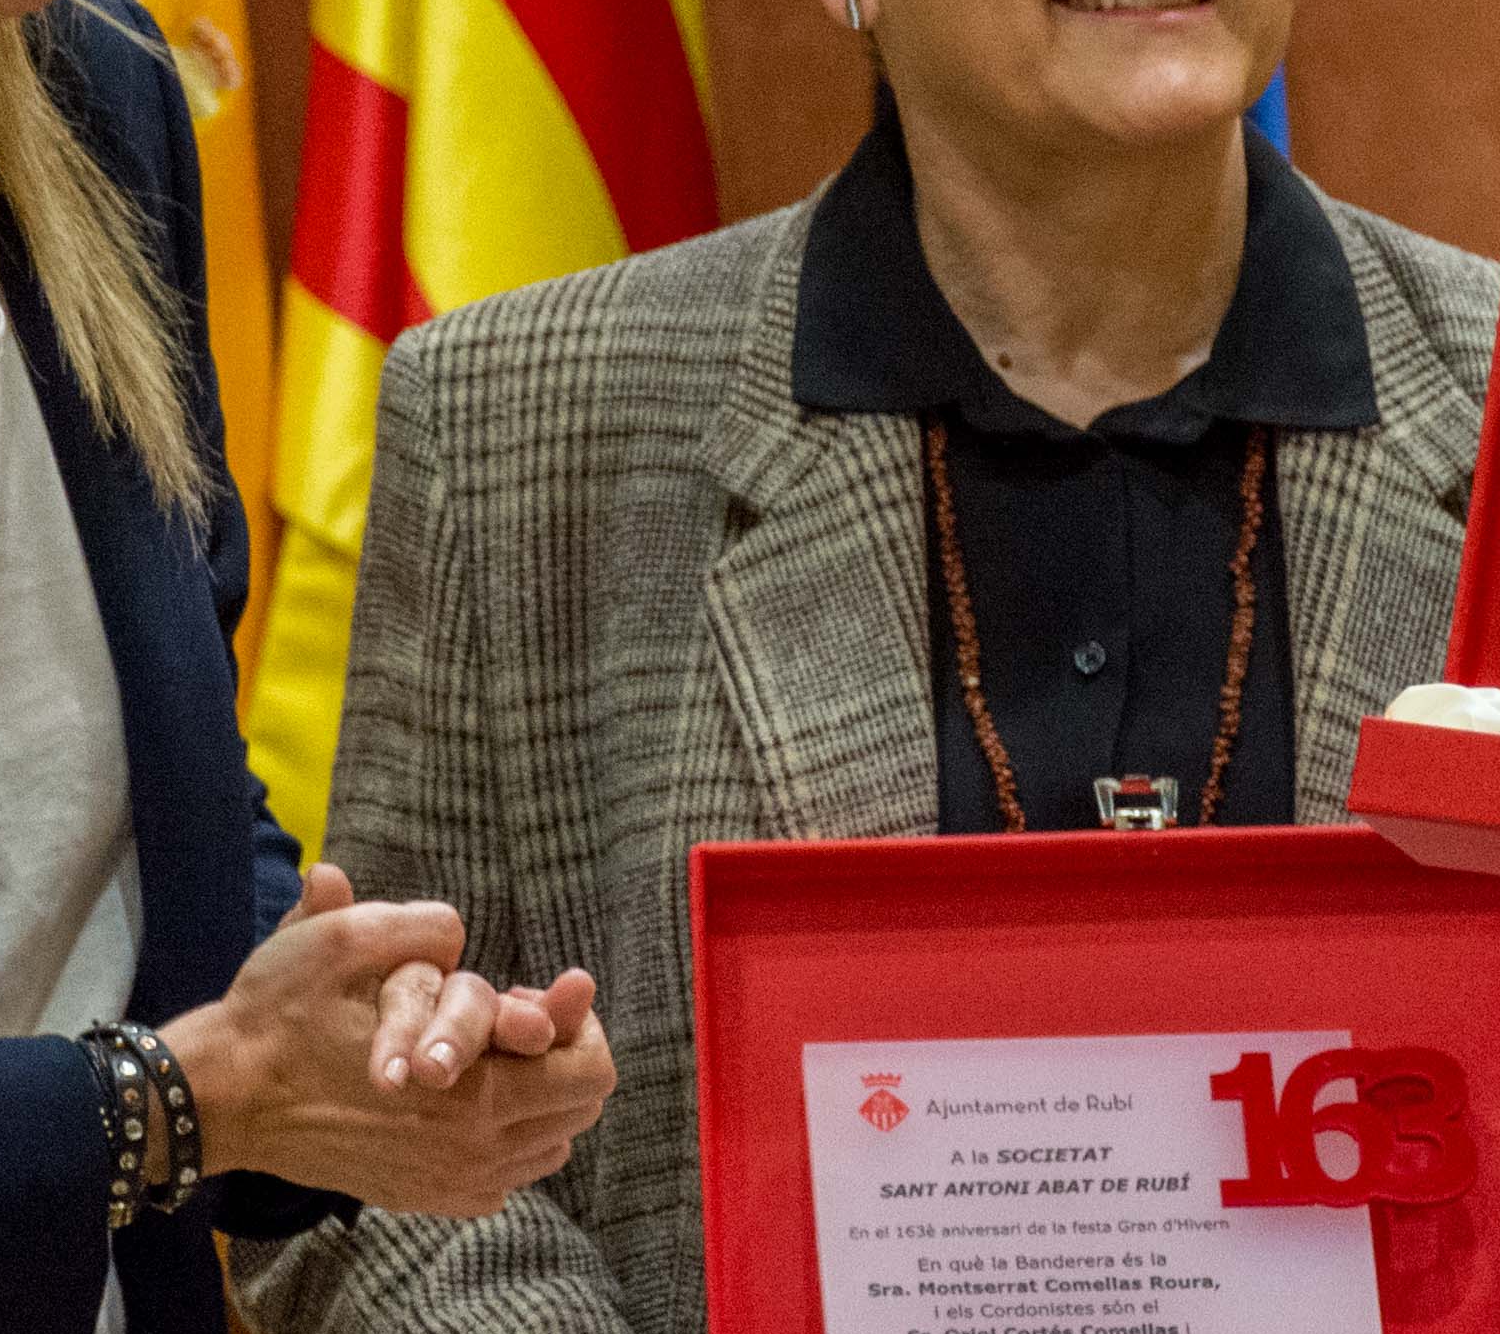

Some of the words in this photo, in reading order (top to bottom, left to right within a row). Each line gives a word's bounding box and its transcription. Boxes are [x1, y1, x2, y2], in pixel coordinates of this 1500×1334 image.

[926, 1097, 1047, 1119] Ajuntament
[1054, 1095, 1080, 1113] de
[1086, 1093, 1134, 1112] Rubí
[1209, 1045, 1479, 1208] 163
[950, 1150, 965, 1165] A
[972, 1149, 989, 1165] la
[996, 1147, 1113, 1165] SOCIETAT
[880, 1182, 939, 1199] SANT
[944, 1179, 1031, 1197] ANTONI
[1037, 1178, 1096, 1195] ABAT
[1099, 1177, 1129, 1194] DE
[1135, 1171, 1192, 1193] RUBÍ
[849, 1227, 869, 1241] En
[876, 1226, 890, 1240] el
[896, 1222, 936, 1239] 163è
[941, 1223, 1022, 1239] aniversari
[1027, 1222, 1047, 1237] de
[1052, 1220, 1067, 1236] la
[1072, 1219, 1114, 1235] festa
[1117, 1219, 1158, 1235] Gran
[1162, 1217, 1230, 1233] d'Hivern
[918, 1257, 942, 1273] En
[949, 1255, 985, 1276] què
[991, 1255, 1008, 1271] la
[1015, 1253, 1115, 1271] Banderera
[1122, 1252, 1144, 1268] és
[1150, 1252, 1167, 1267] la
[868, 1282, 911, 1298] Sra.
[918, 1278, 1039, 1297] Montserrat
[1044, 1276, 1143, 1294] Comellas
[1150, 1275, 1221, 1293] Roura,
[933, 1305, 940, 1320] i
[946, 1303, 972, 1320] els
[979, 1301, 1095, 1319] Cordonistes
[1101, 1299, 1136, 1316] són
[1142, 1299, 1159, 1315] el
